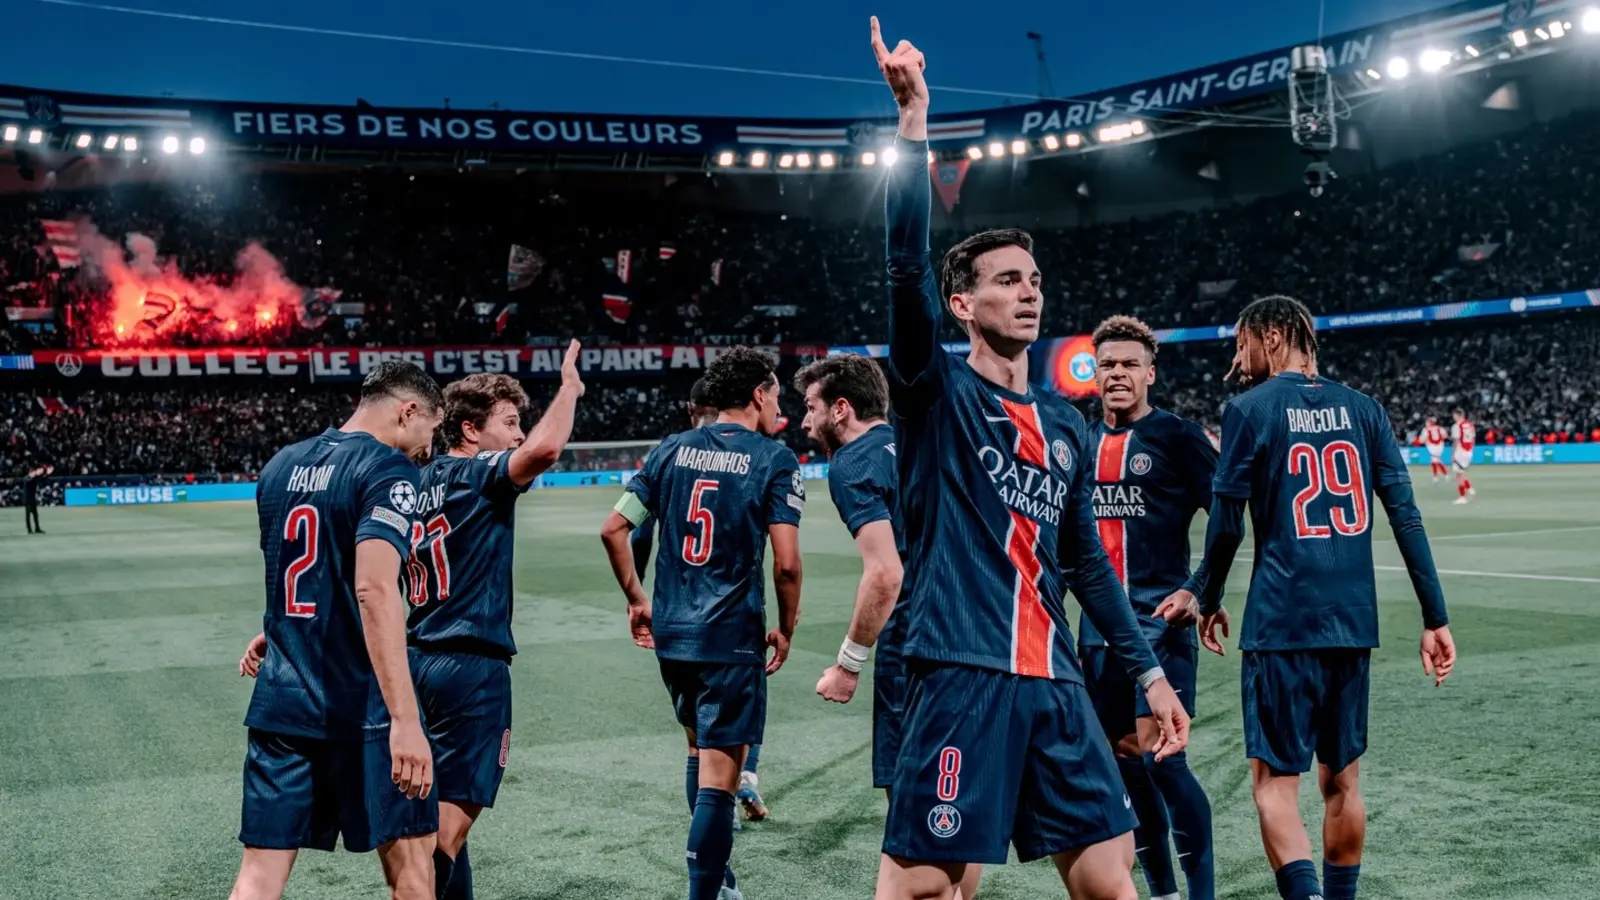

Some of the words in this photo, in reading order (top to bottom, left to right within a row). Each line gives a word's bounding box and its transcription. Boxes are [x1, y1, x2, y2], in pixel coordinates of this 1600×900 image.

[1021, 97, 1116, 133] PARIS
[1126, 35, 1373, 113] SAINT-GERAIN
[233, 111, 345, 135] FIERS
[358, 114, 408, 137] DE
[419, 117, 496, 140] NOS
[508, 120, 702, 144] COULEURS
[313, 351, 350, 376] LE
[434, 350, 521, 374] C'EST
[581, 347, 663, 371] PARC
[1286, 406, 1352, 433] BARCOLA
[674, 445, 751, 476] MARQUINHOS
[978, 445, 1068, 510] QATAR
[111, 486, 174, 504] REUSE
[998, 484, 1061, 526] AIRWAYS
[1091, 485, 1145, 504] ATAR
[1287, 440, 1369, 539] 29
[682, 478, 720, 567] 5
[284, 503, 319, 618] 2
[937, 746, 962, 801] 8
